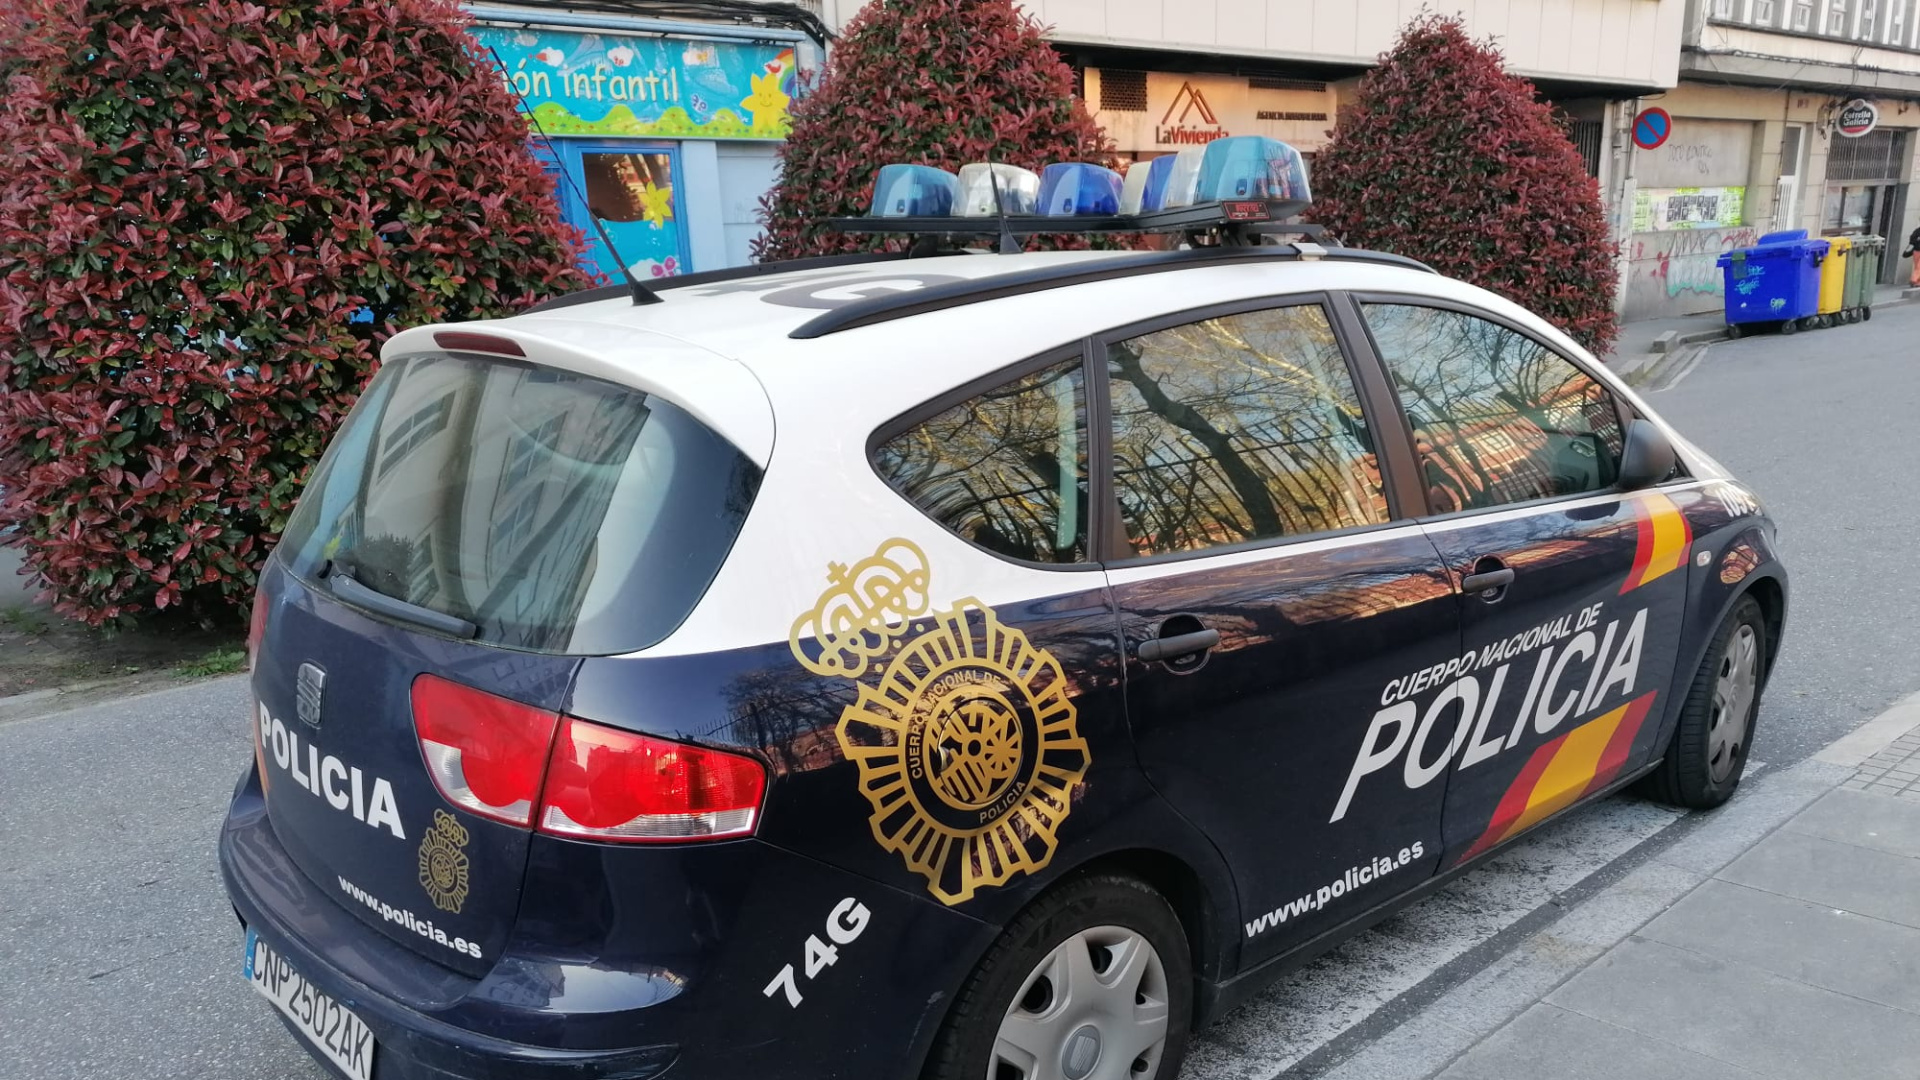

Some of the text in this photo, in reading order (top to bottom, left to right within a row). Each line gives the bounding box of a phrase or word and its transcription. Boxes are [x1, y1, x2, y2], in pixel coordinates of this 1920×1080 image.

[561, 62, 679, 102] infantil
[1843, 110, 1872, 119] Estrella
[1380, 601, 1604, 706] CUERPO NACIONAL DE
[909, 713, 926, 780] CUERPO
[1329, 607, 1649, 824] POLICIA
[259, 699, 407, 841] POLICIA
[979, 780, 1026, 825] POLICIA
[337, 874, 483, 960] www.policia.es
[1244, 840, 1425, 939] www.policia.es
[762, 896, 872, 1009] 74G
